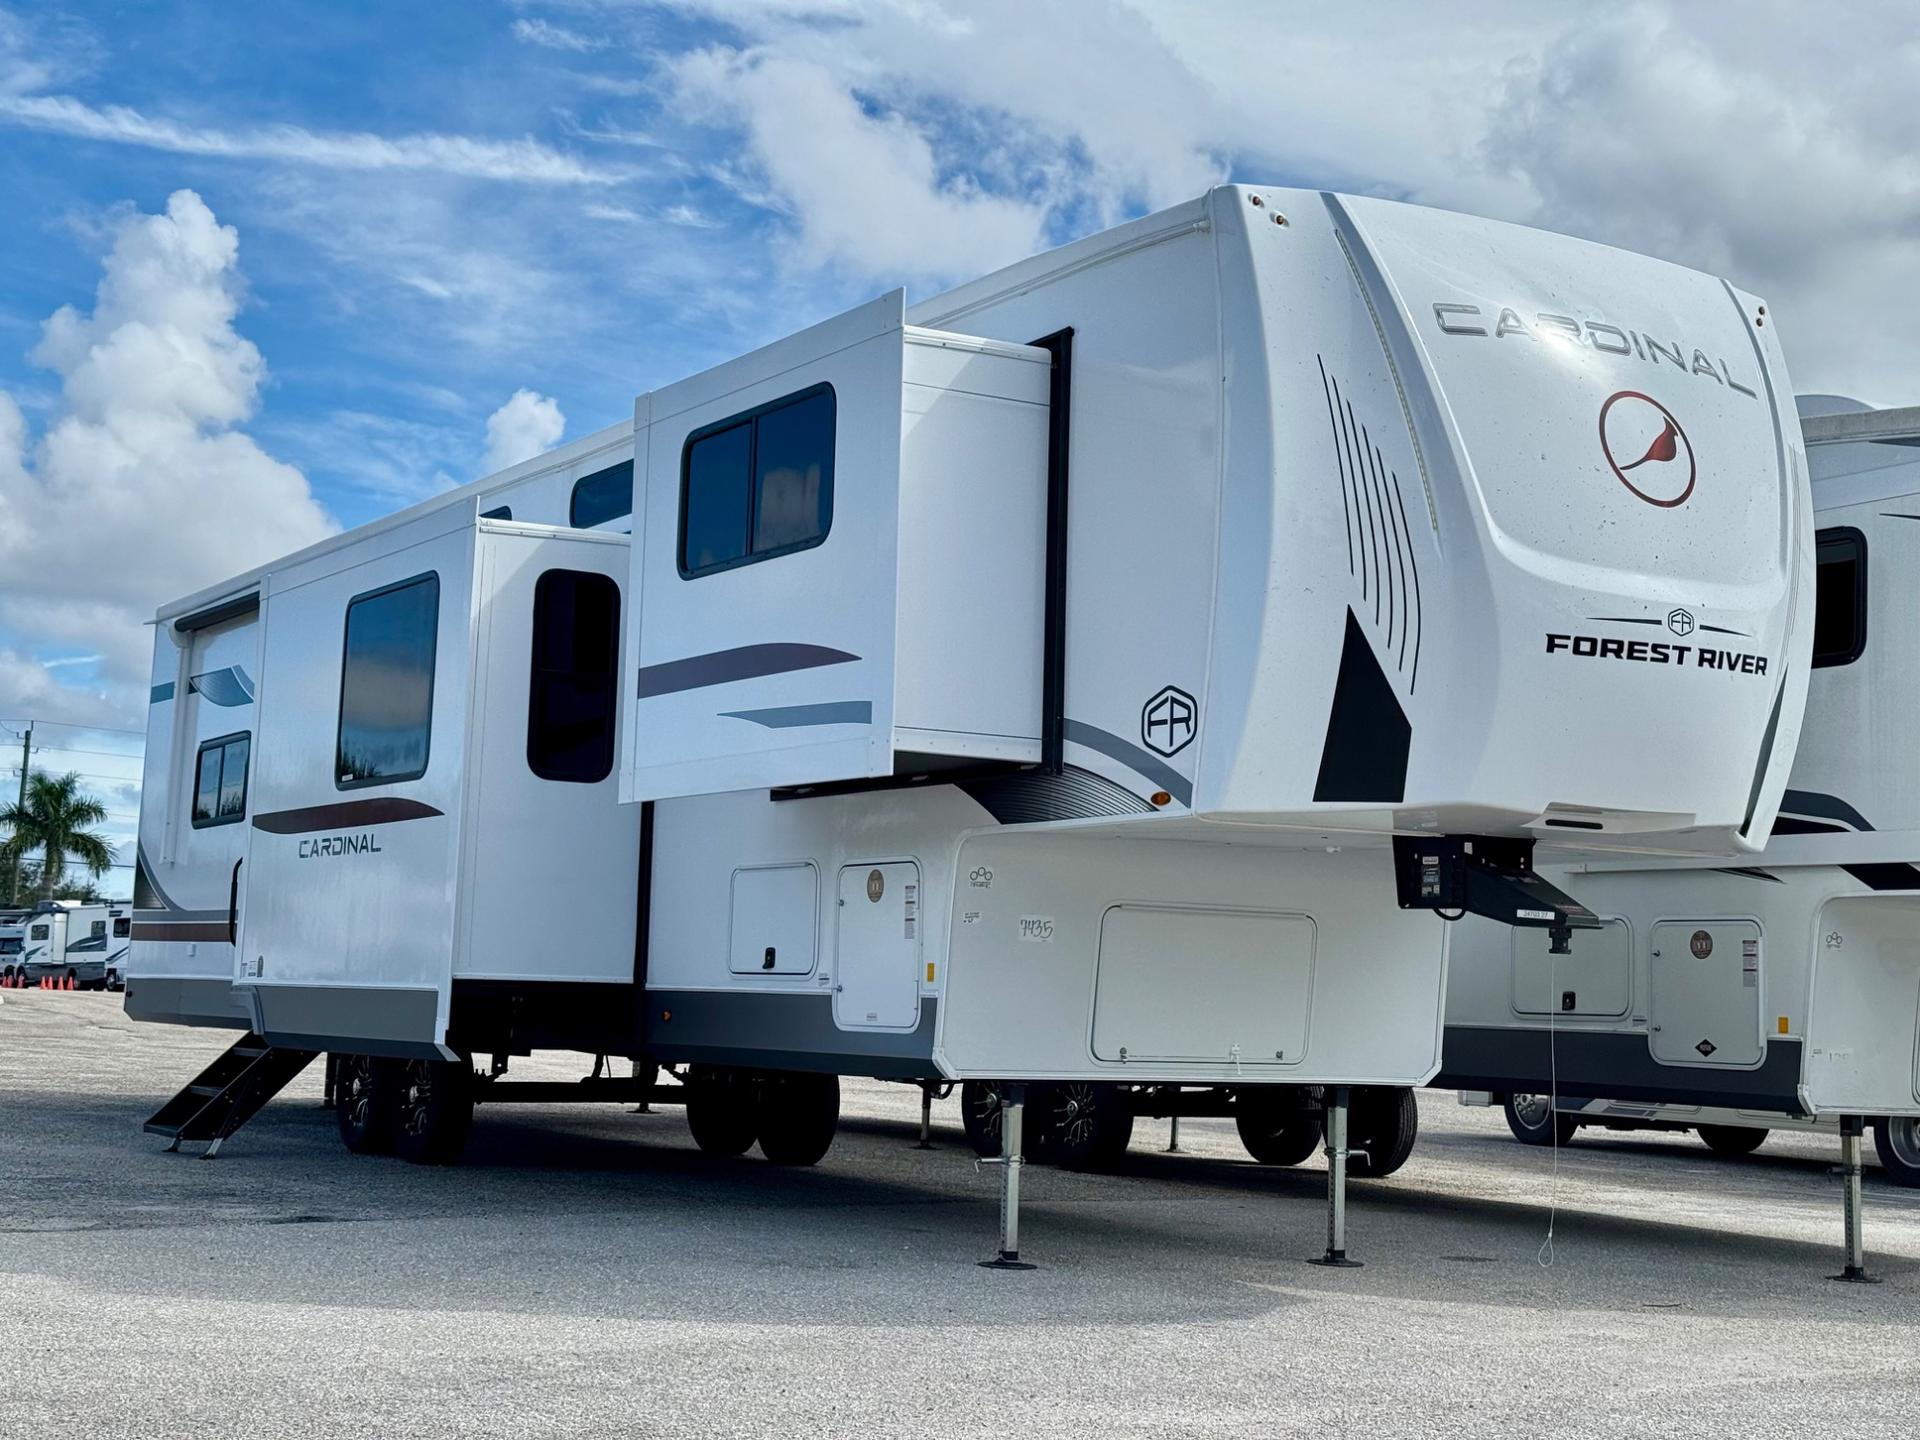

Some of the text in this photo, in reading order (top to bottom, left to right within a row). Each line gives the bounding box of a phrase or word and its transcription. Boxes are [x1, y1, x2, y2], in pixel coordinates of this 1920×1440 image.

[1433, 302, 1757, 399] CARDINAL
[1546, 634, 1768, 675] FOREST RIVER
[299, 834, 382, 858] CARDINAL
[1020, 919, 1053, 939] 7435
